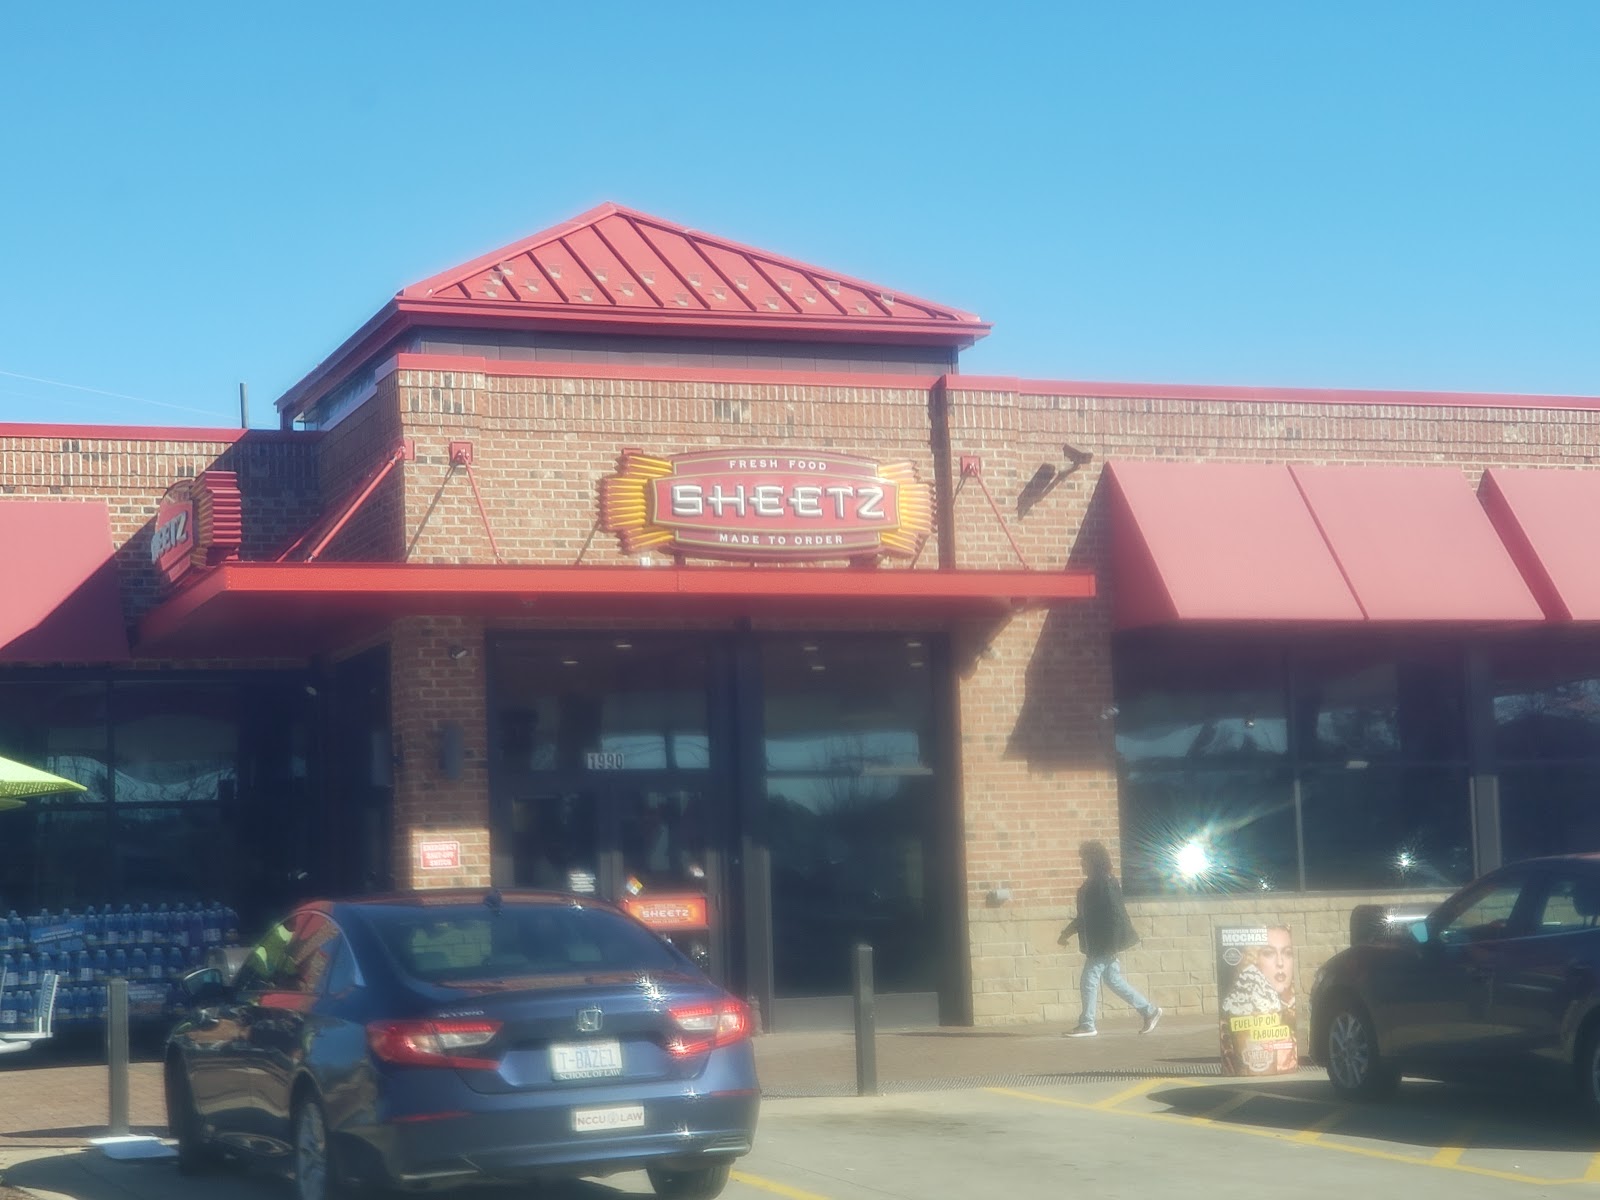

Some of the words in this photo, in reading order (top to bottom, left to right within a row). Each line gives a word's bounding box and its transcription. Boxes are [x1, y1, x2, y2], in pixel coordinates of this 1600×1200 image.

[729, 460, 778, 469] FRESH
[789, 459, 827, 471] FOOD
[671, 484, 885, 520] SHEETZ
[719, 533, 760, 544] MADE
[769, 535, 786, 545] TO
[794, 535, 843, 545] ORDER
[590, 753, 623, 769] 1990
[642, 909, 689, 918] SHEETZ
[1222, 933, 1268, 943] MOCHAS
[1234, 1019, 1251, 1030] FUEL
[1253, 1016, 1264, 1027] UP
[1265, 1014, 1277, 1025] ON
[1253, 1027, 1288, 1040] FABULOUS
[560, 1071, 592, 1080] SCHOOL
[592, 1069, 603, 1077] OF
[604, 1068, 622, 1076] LAW
[577, 1115, 606, 1125] NCCU
[620, 1112, 643, 1122] LAW
